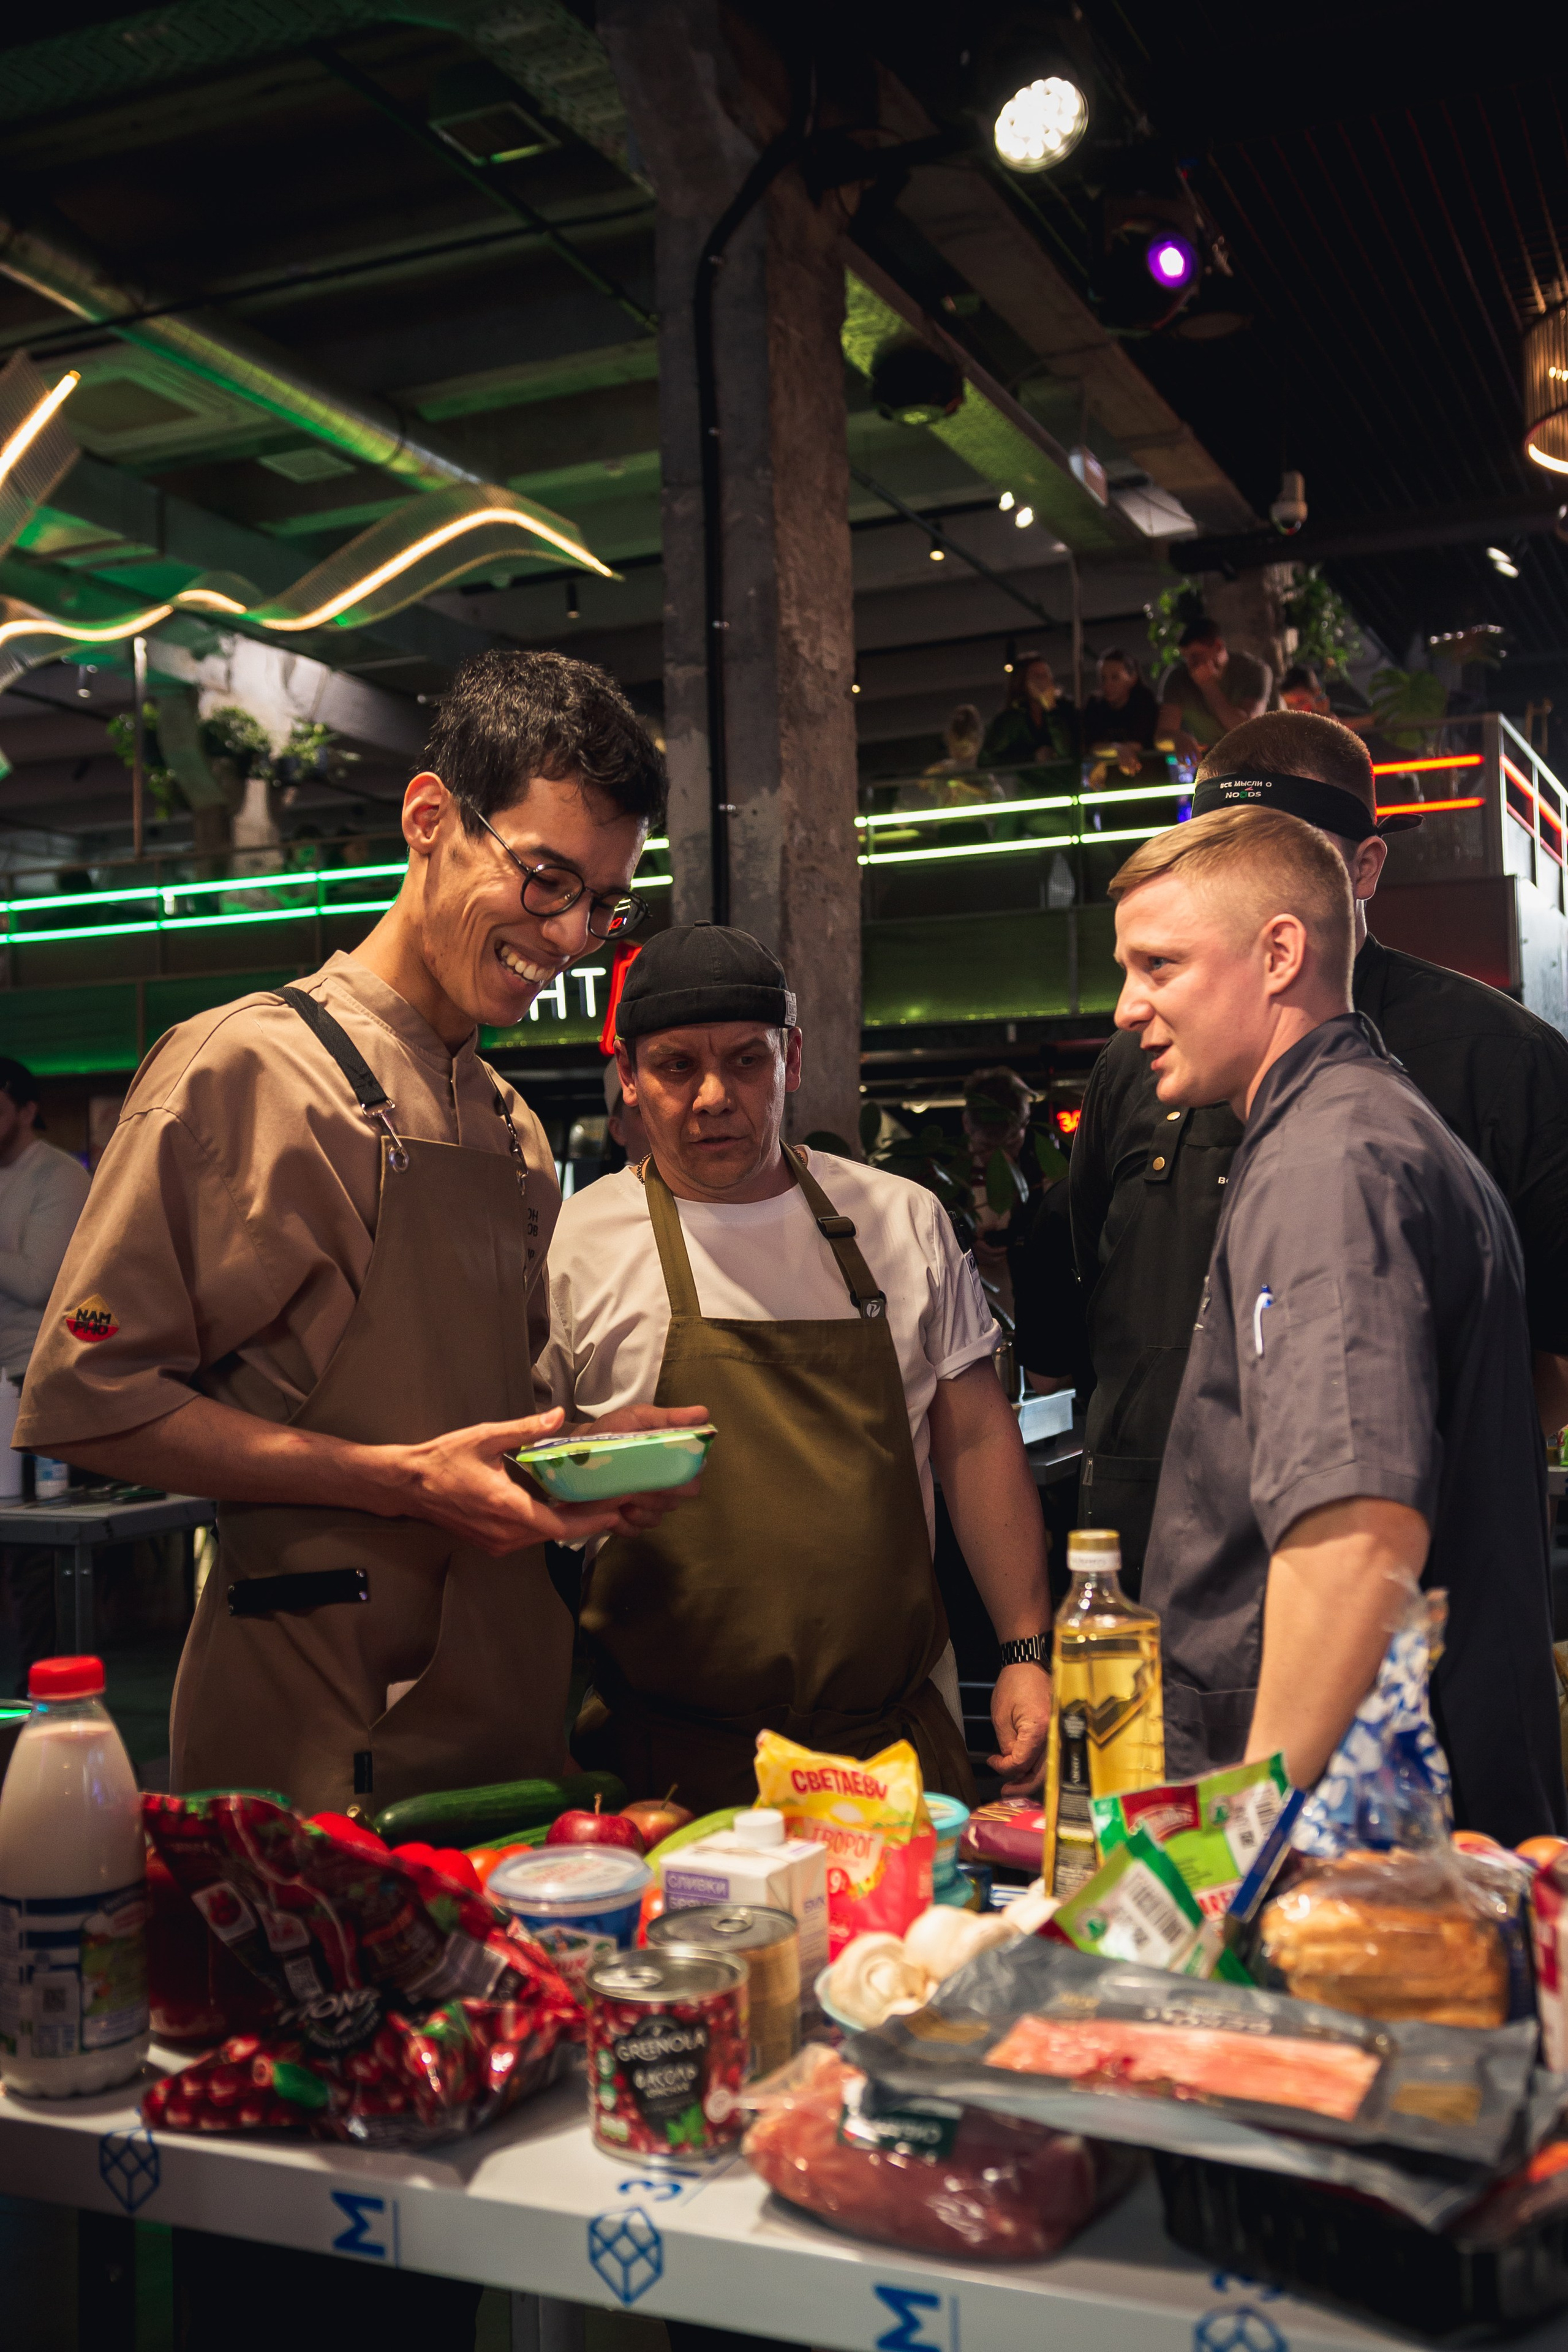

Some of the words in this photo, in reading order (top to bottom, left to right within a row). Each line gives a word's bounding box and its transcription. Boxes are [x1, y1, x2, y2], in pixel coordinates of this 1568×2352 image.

[76, 1308, 111, 1325] NAM
[74, 1321, 108, 1335] PHO
[667, 1874, 726, 1896] СЛИВКИ
[616, 2027, 707, 2062] GREENOLA
